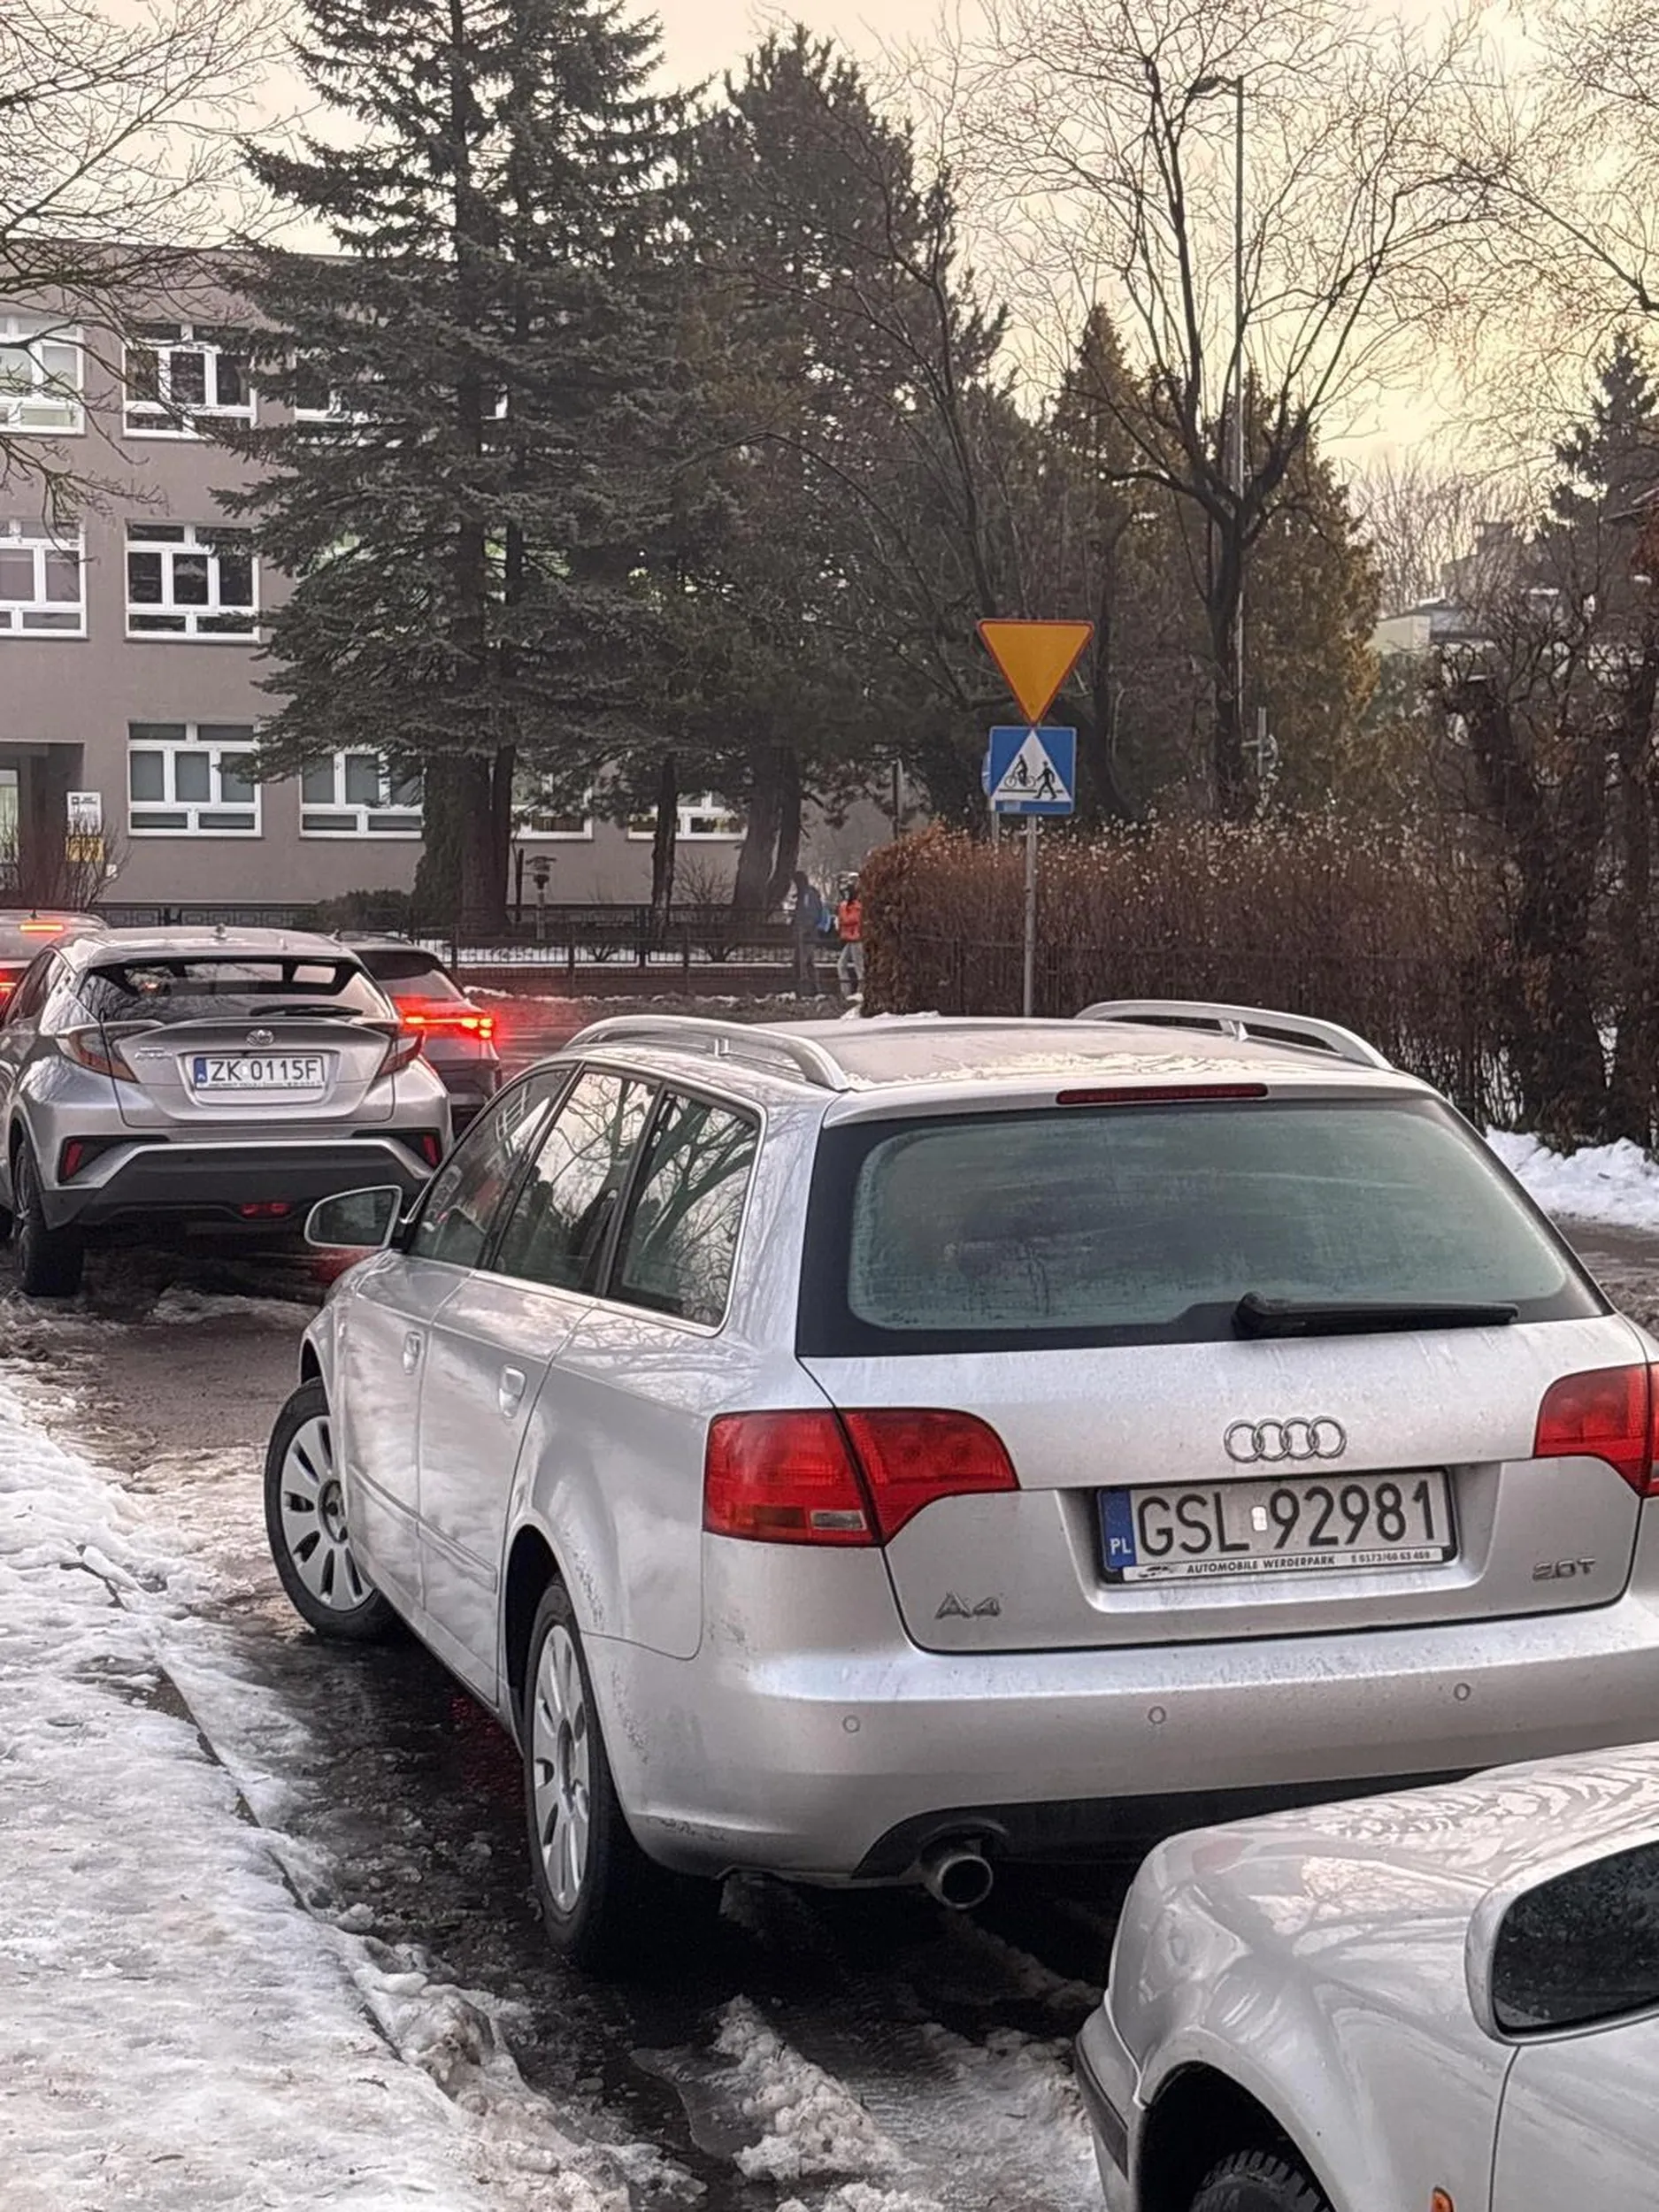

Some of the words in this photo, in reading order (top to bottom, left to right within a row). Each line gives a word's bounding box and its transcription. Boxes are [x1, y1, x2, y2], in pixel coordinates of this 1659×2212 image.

[210, 1060, 242, 1081] ZK
[250, 1059, 319, 1081] 0115F
[1138, 1492, 1249, 1556] GSL
[1270, 1479, 1434, 1549] 92981
[1110, 1538, 1132, 1555] PL
[1187, 1561, 1258, 1574] AUTOMOBILE
[1263, 1555, 1335, 1570] WERDERPARK
[934, 1591, 1001, 1619] A4
